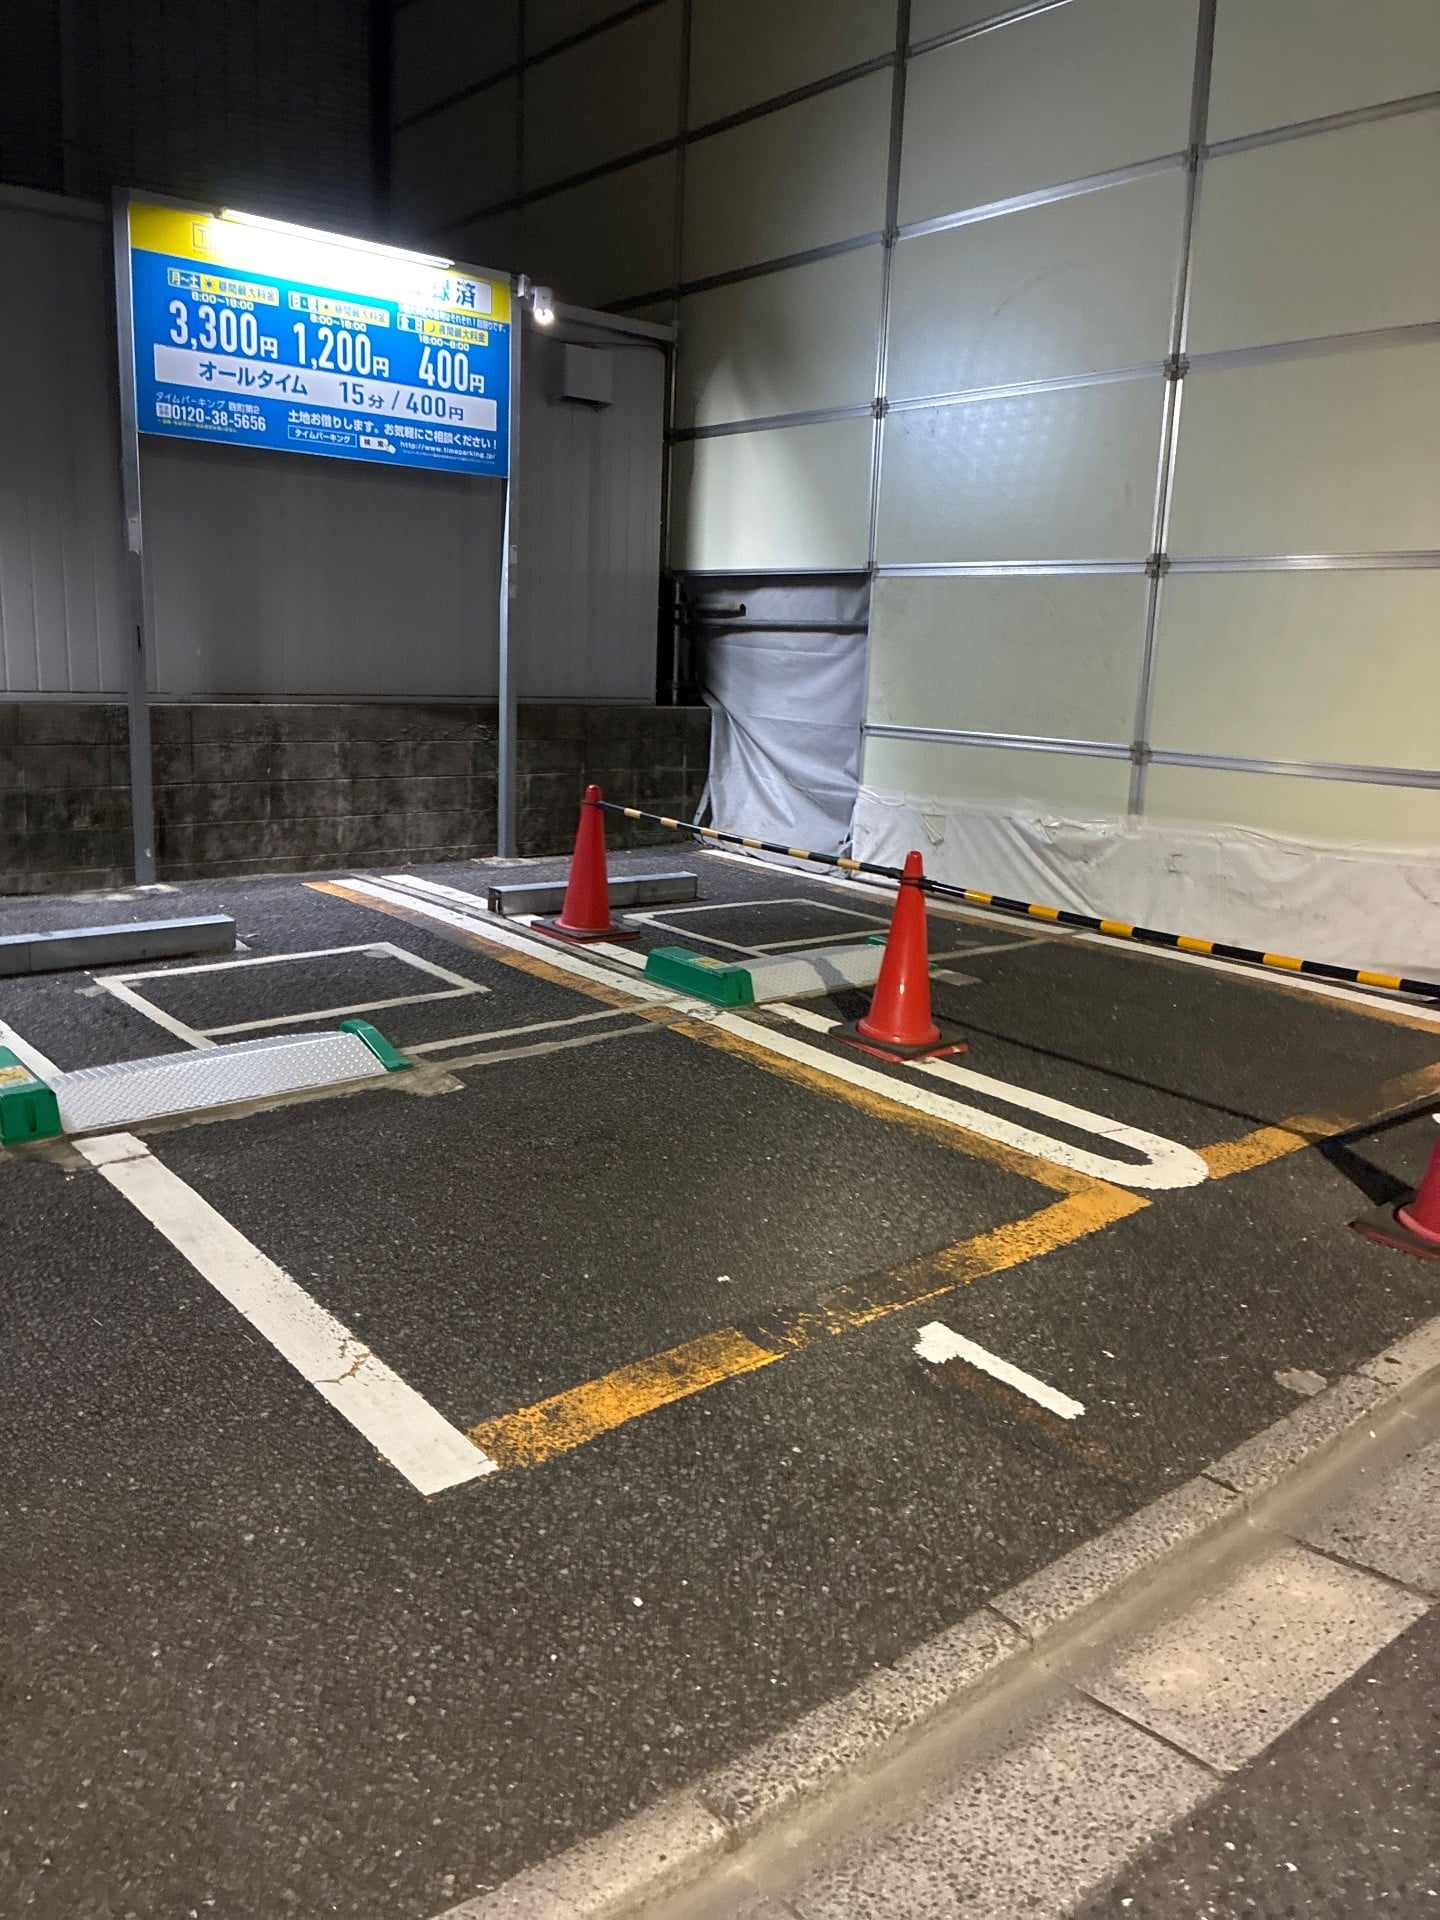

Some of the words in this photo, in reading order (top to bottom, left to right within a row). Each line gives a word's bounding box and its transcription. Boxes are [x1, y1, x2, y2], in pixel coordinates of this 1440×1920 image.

[169, 299, 279, 360] 3,300円
[293, 321, 390, 378] 1,200円
[198, 360, 308, 396] オールタイム
[418, 345, 486, 394] 400円
[172, 404, 267, 433] 0120-38-5656
[294, 428, 351, 445] タイムパーキング
[912, 1320, 1087, 1421] 1
